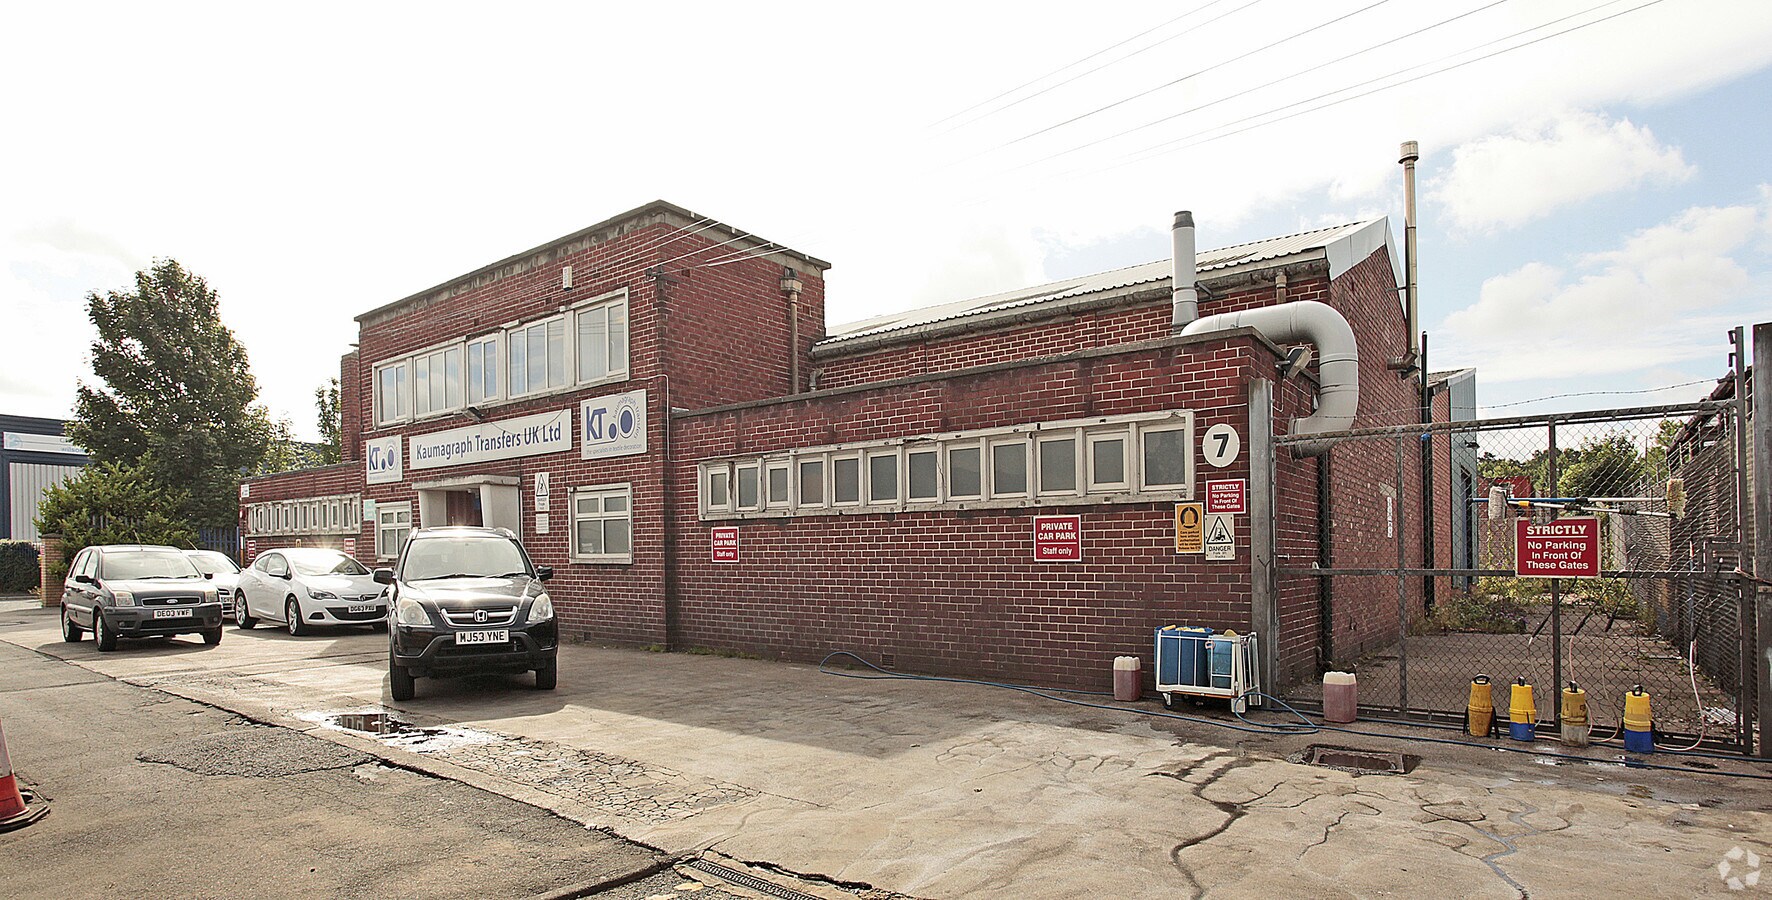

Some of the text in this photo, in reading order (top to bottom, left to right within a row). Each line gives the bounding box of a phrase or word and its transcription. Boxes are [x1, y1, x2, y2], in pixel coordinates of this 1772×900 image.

[416, 436, 472, 460] Kaumagraph
[475, 430, 521, 452] Transfers
[523, 427, 540, 445] UK
[542, 422, 561, 443] Ltd
[1212, 433, 1230, 458] 7
[1041, 522, 1073, 530] PRIVATE
[1526, 525, 1587, 535] STRICTLY
[1038, 532, 1077, 540] CAR PARK
[1527, 541, 1587, 551] No Parking
[1042, 547, 1072, 556] Staff only
[1543, 551, 1568, 559] Front
[1570, 551, 1582, 559] Of
[1526, 560, 1589, 569] These Gates
[460, 631, 505, 643] MJ53 YNE
